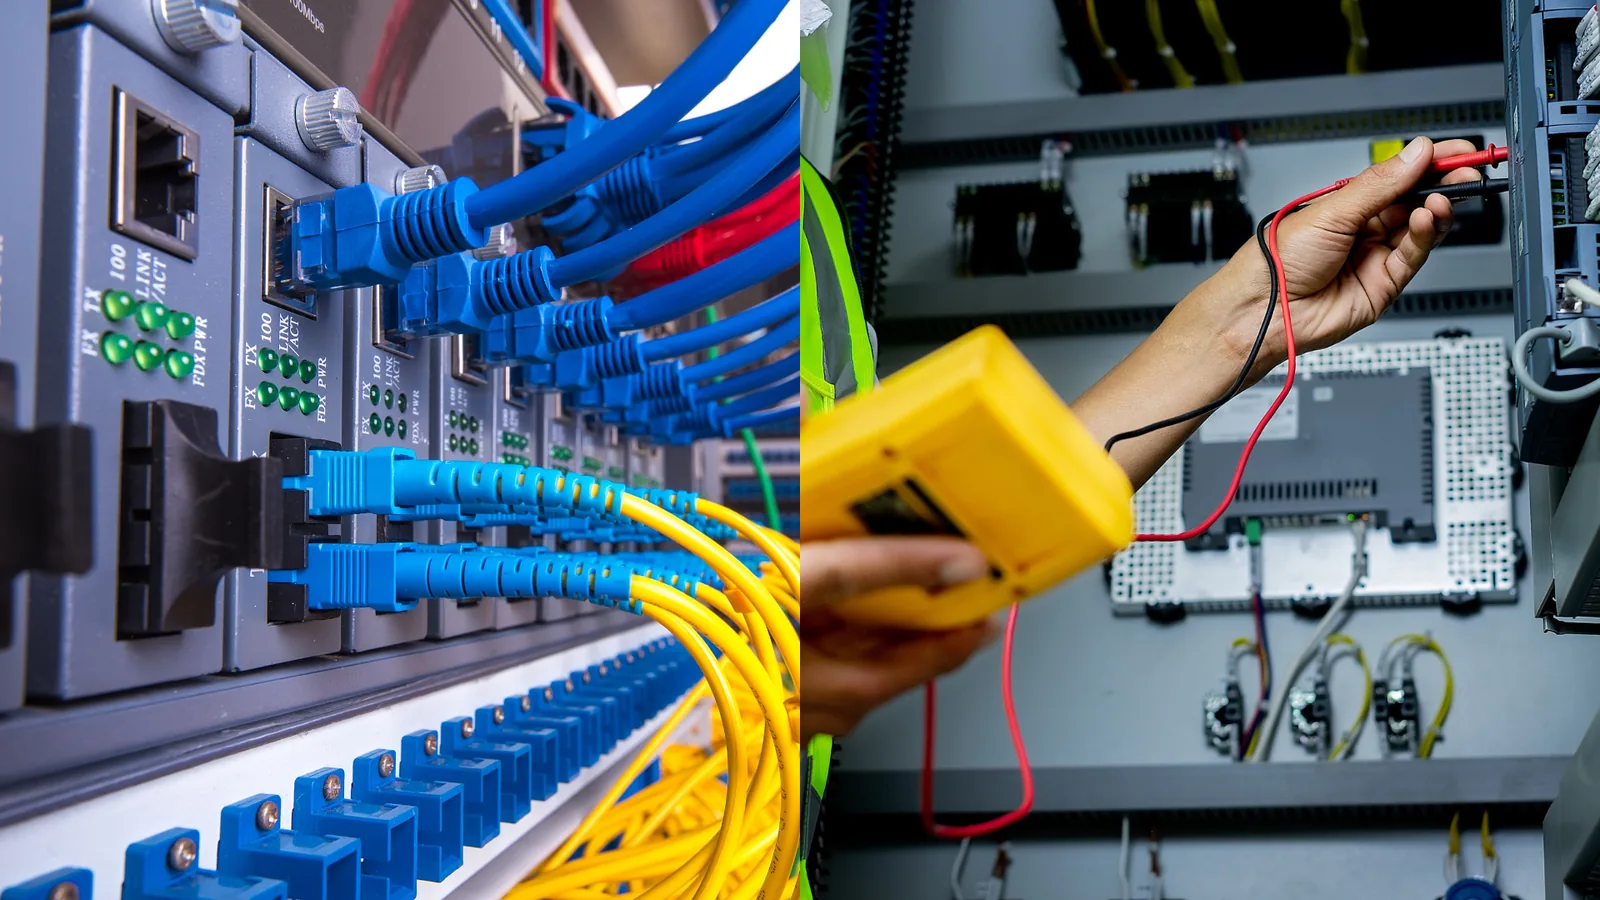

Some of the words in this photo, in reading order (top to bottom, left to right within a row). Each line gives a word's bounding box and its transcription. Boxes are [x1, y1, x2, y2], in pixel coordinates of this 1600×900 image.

[290, 0, 325, 33] 00Mbps
[109, 243, 127, 282] 100
[134, 248, 152, 299] LINK
[150, 256, 167, 305] /ACT
[83, 286, 102, 313] TX
[81, 328, 100, 357] FX
[194, 316, 208, 353] PWR
[261, 312, 272, 343] 100
[279, 313, 290, 353] LINK
[288, 316, 300, 357] /ACT
[245, 341, 257, 366] TX
[372, 355, 382, 380] 100
[192, 353, 207, 387] FDX
[317, 357, 327, 389] PWR
[385, 356, 393, 387] LINK
[392, 357, 401, 390] /ACT
[244, 386, 256, 410] FX
[362, 380, 371, 400] TX
[412, 389, 420, 416] PWR
[317, 394, 327, 423] FDX
[361, 417, 370, 435] FX
[412, 421, 420, 445] FDX
